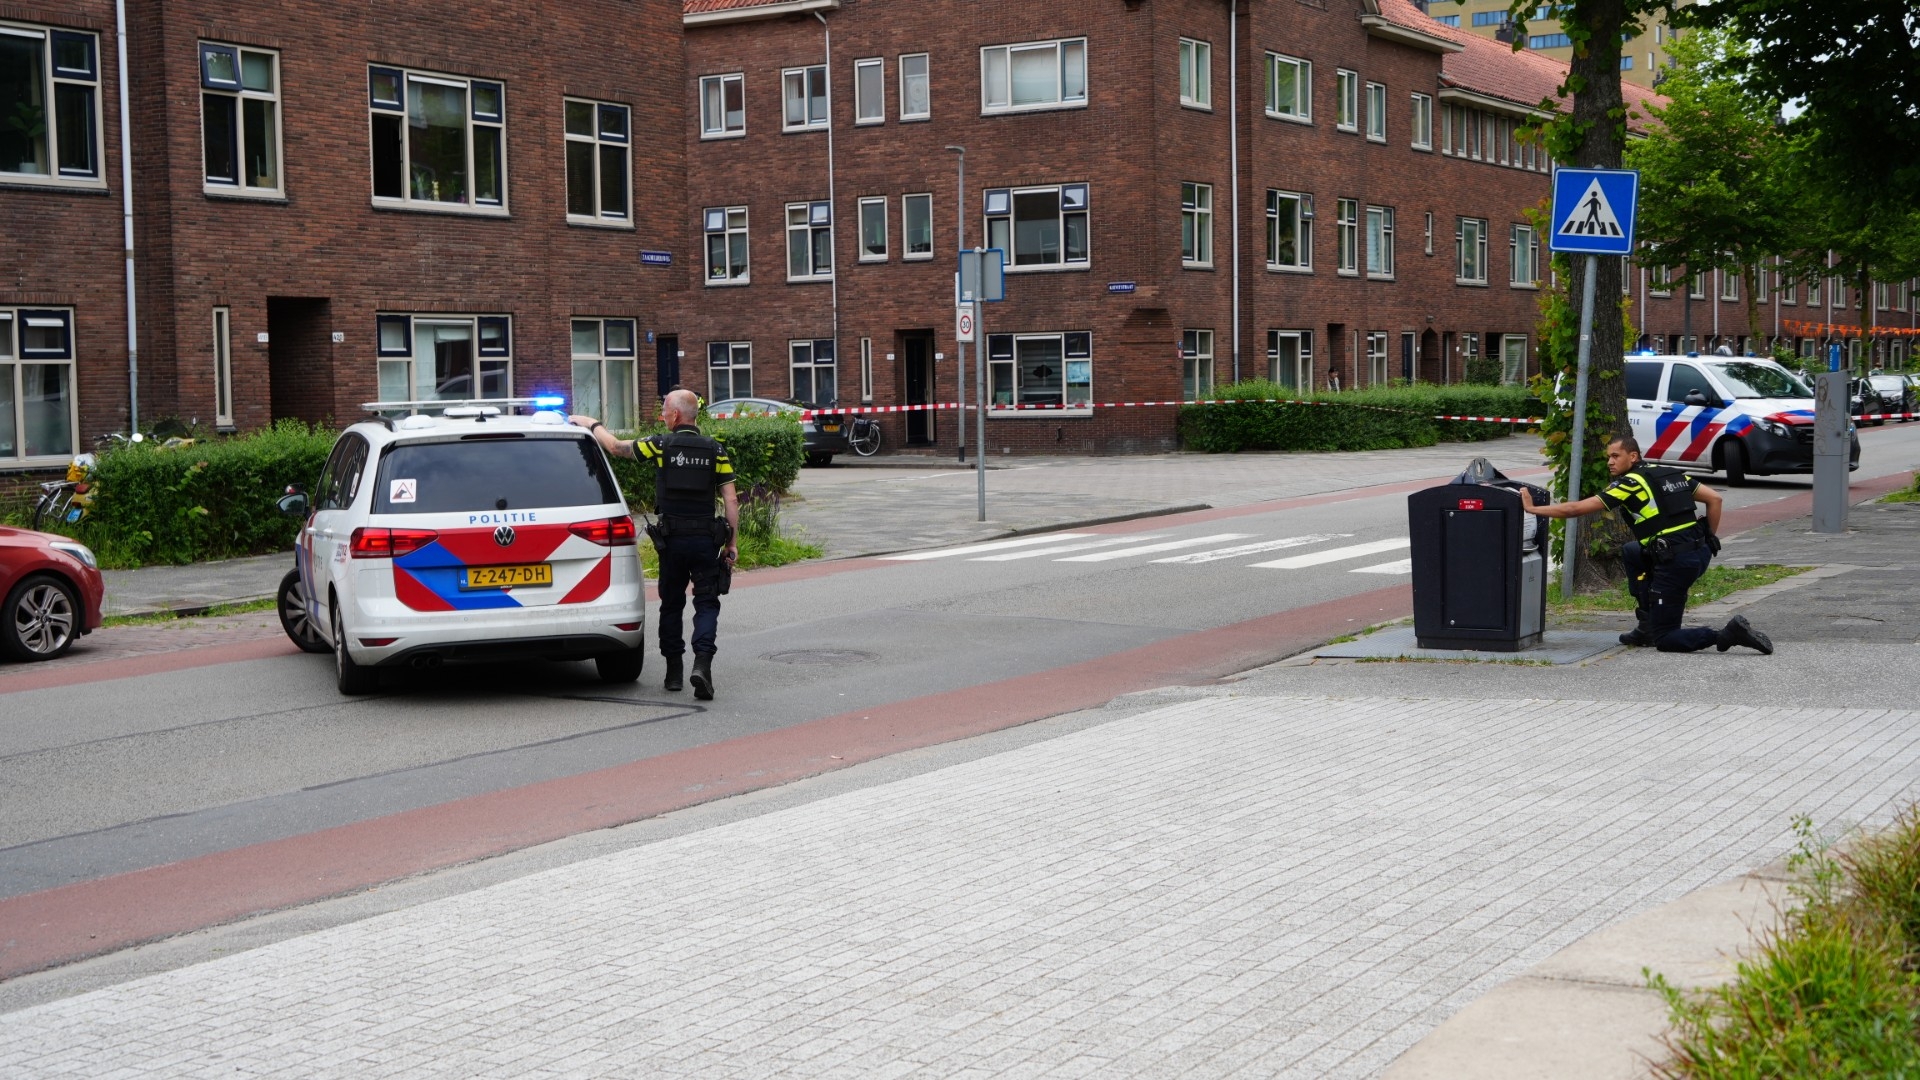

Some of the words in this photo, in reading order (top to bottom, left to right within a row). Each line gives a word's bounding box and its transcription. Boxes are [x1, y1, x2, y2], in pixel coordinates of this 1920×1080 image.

[962, 320, 970, 329] 30
[670, 452, 710, 466] POLITIE
[1662, 480, 1690, 492] POLITIE
[469, 512, 537, 524] POLITIE
[472, 566, 546, 584] Z-247-DH
